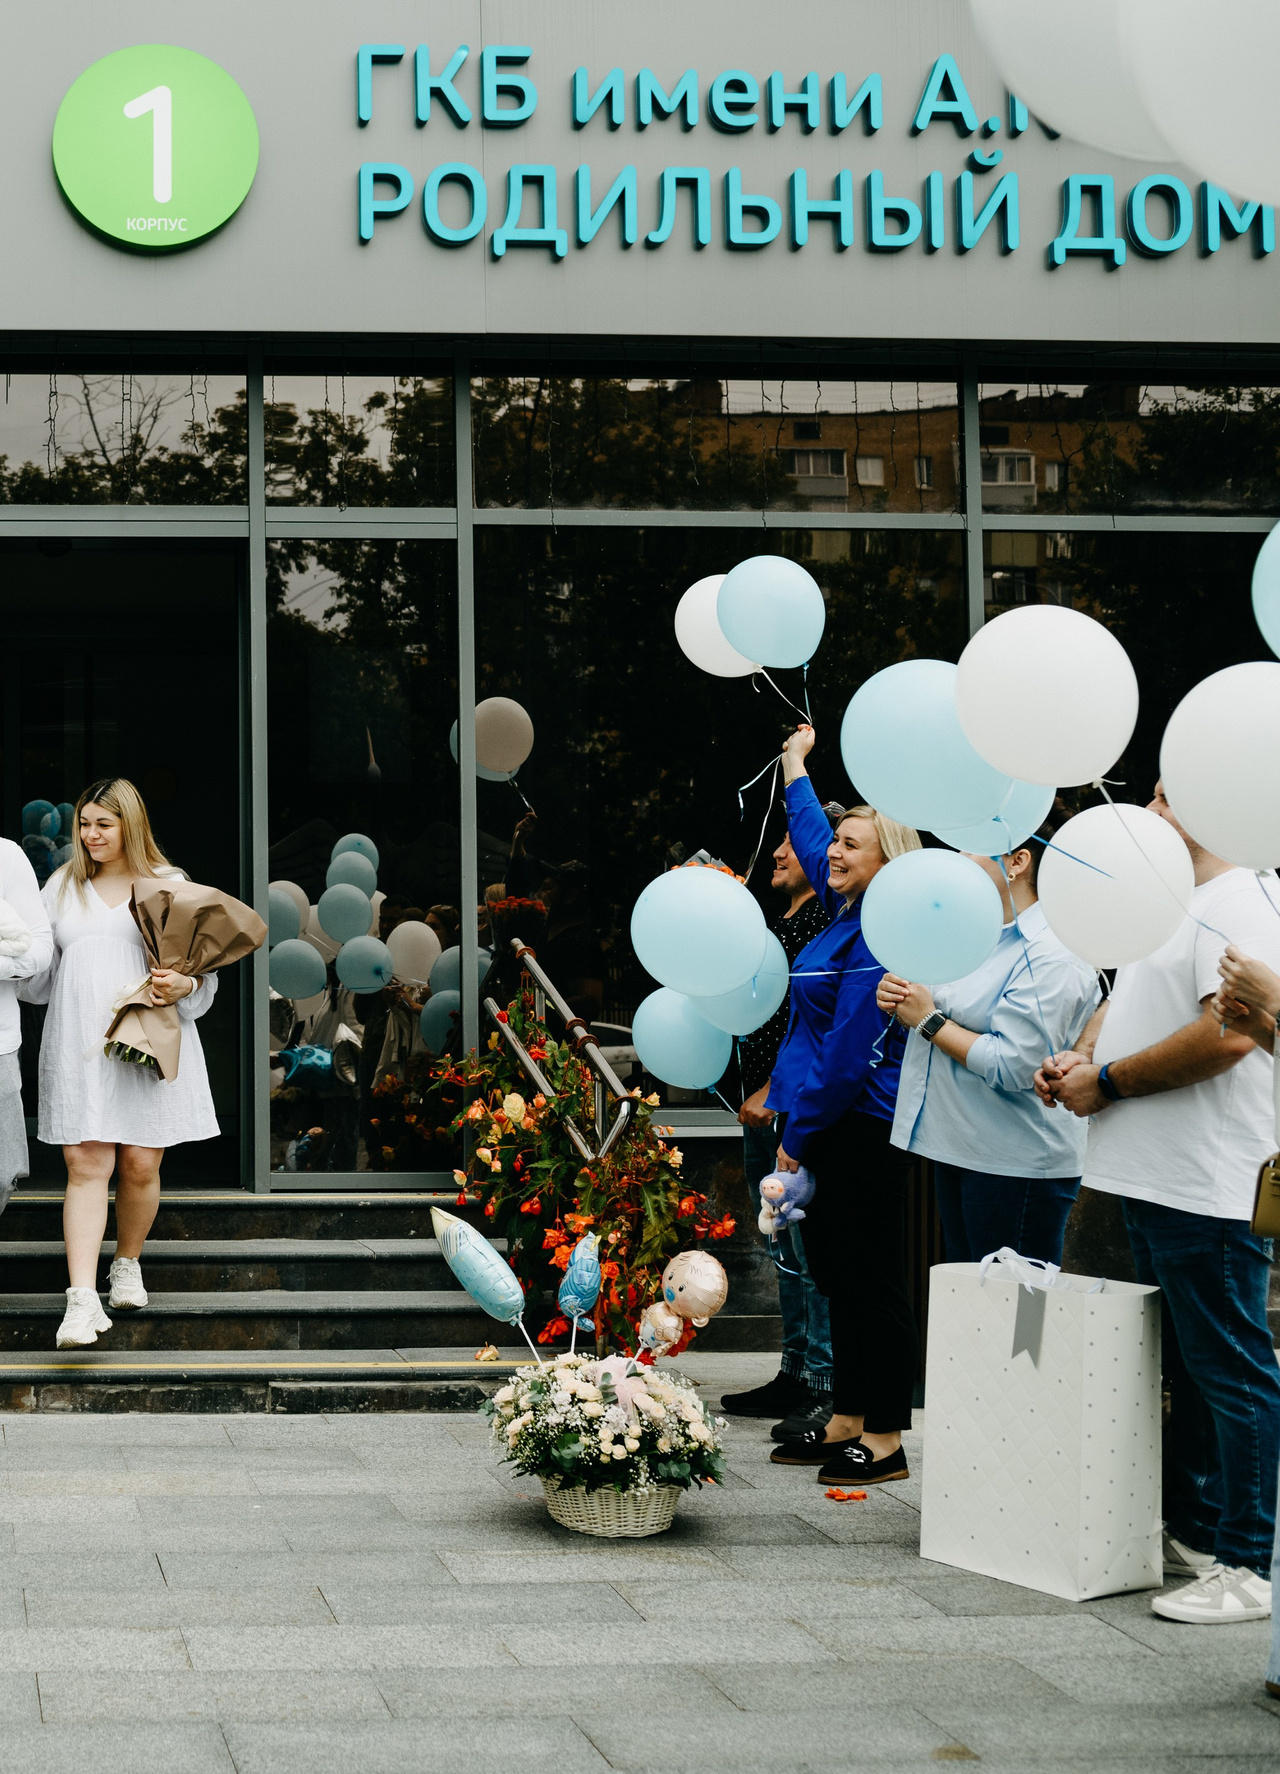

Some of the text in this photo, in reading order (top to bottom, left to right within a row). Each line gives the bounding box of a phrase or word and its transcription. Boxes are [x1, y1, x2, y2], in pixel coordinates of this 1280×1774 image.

[356, 43, 538, 127] ГКБ
[570, 66, 884, 134] имени
[123, 85, 172, 203] 1
[126, 217, 188, 232] КОРПУС
[357, 148, 1277, 268] РОДИЛЬНЫЙ ДОМ
